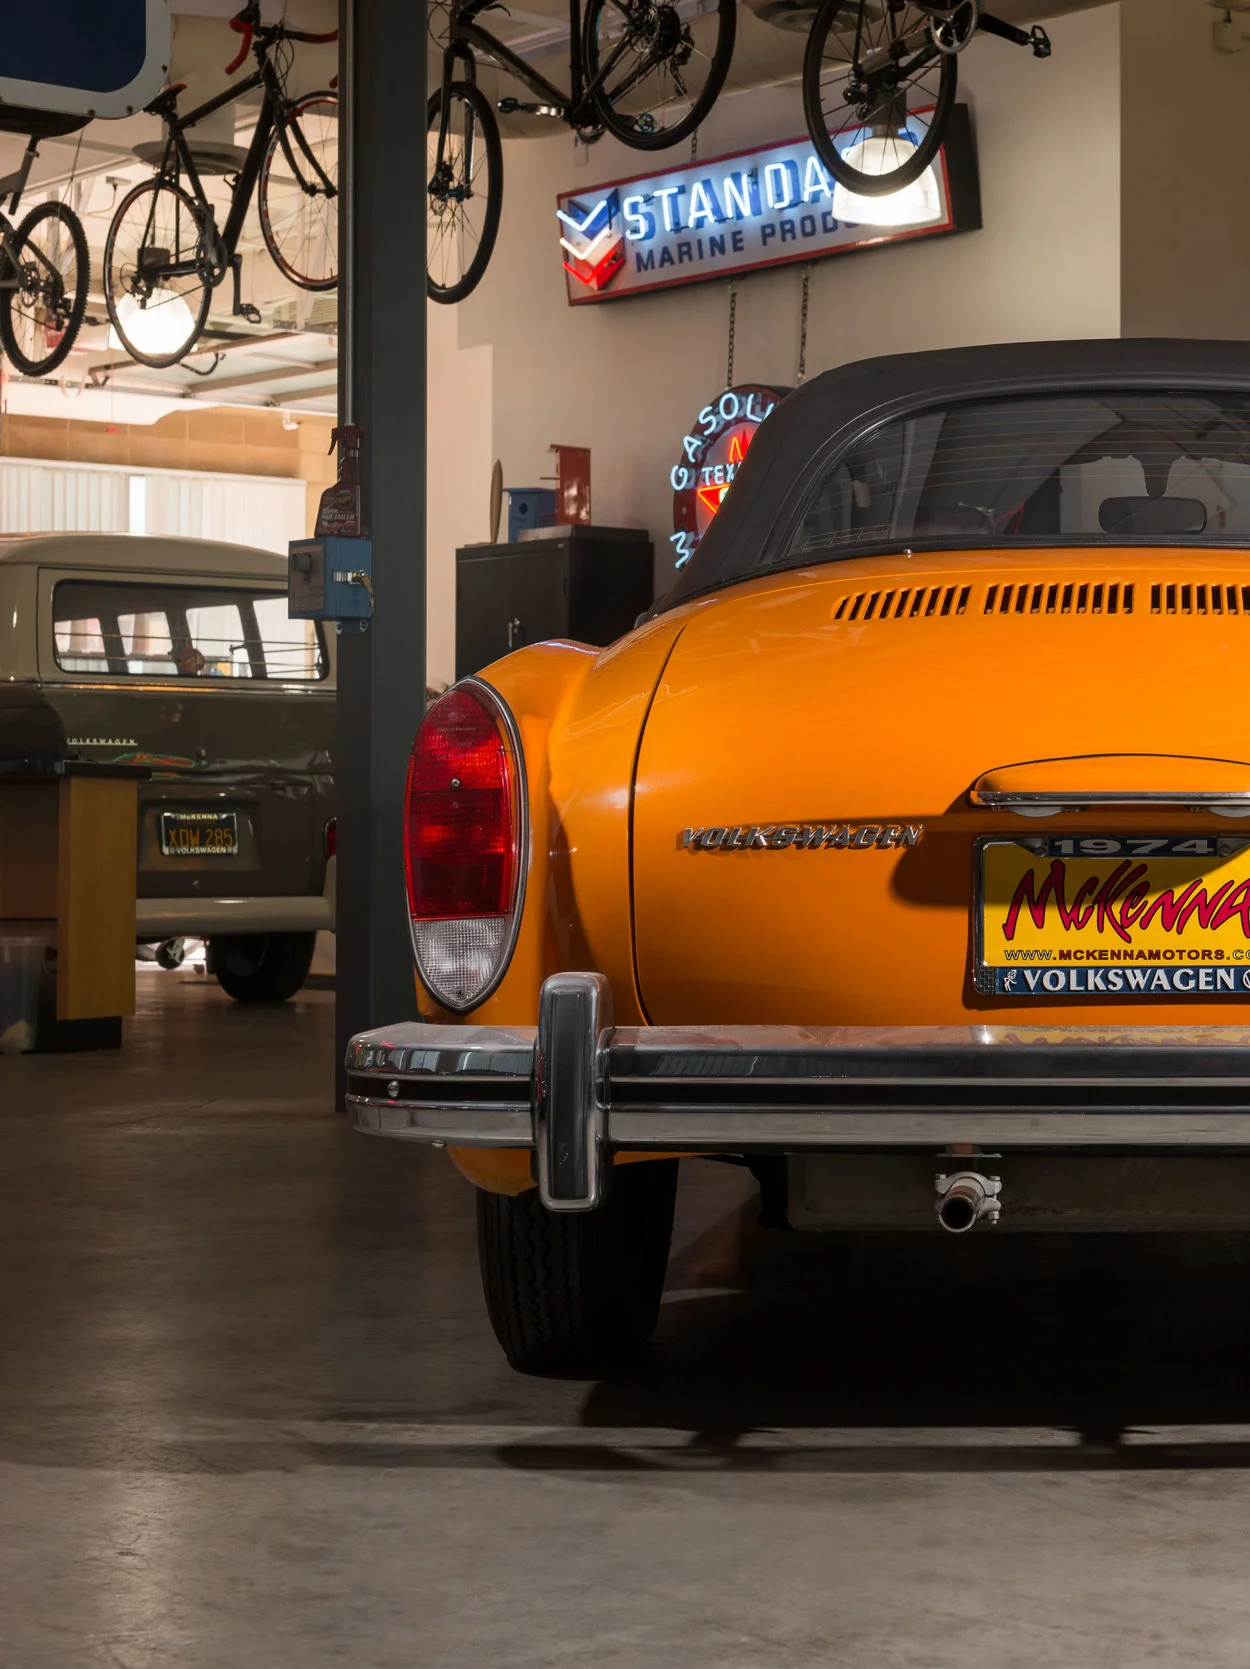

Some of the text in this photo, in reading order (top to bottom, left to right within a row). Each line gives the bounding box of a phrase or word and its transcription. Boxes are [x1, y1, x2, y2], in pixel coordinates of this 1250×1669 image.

[623, 148, 841, 241] STANDA
[635, 210, 860, 273] MARINE PROD
[670, 392, 775, 491] GASOLI
[701, 461, 742, 487] TEX
[169, 828, 233, 848] XDW 285
[683, 824, 922, 847] VOLKSWAGEN
[1054, 838, 1214, 855] 1974
[176, 846, 227, 854] VOLKSWAGEN
[1024, 968, 1235, 991] VOLKSWAGEN
